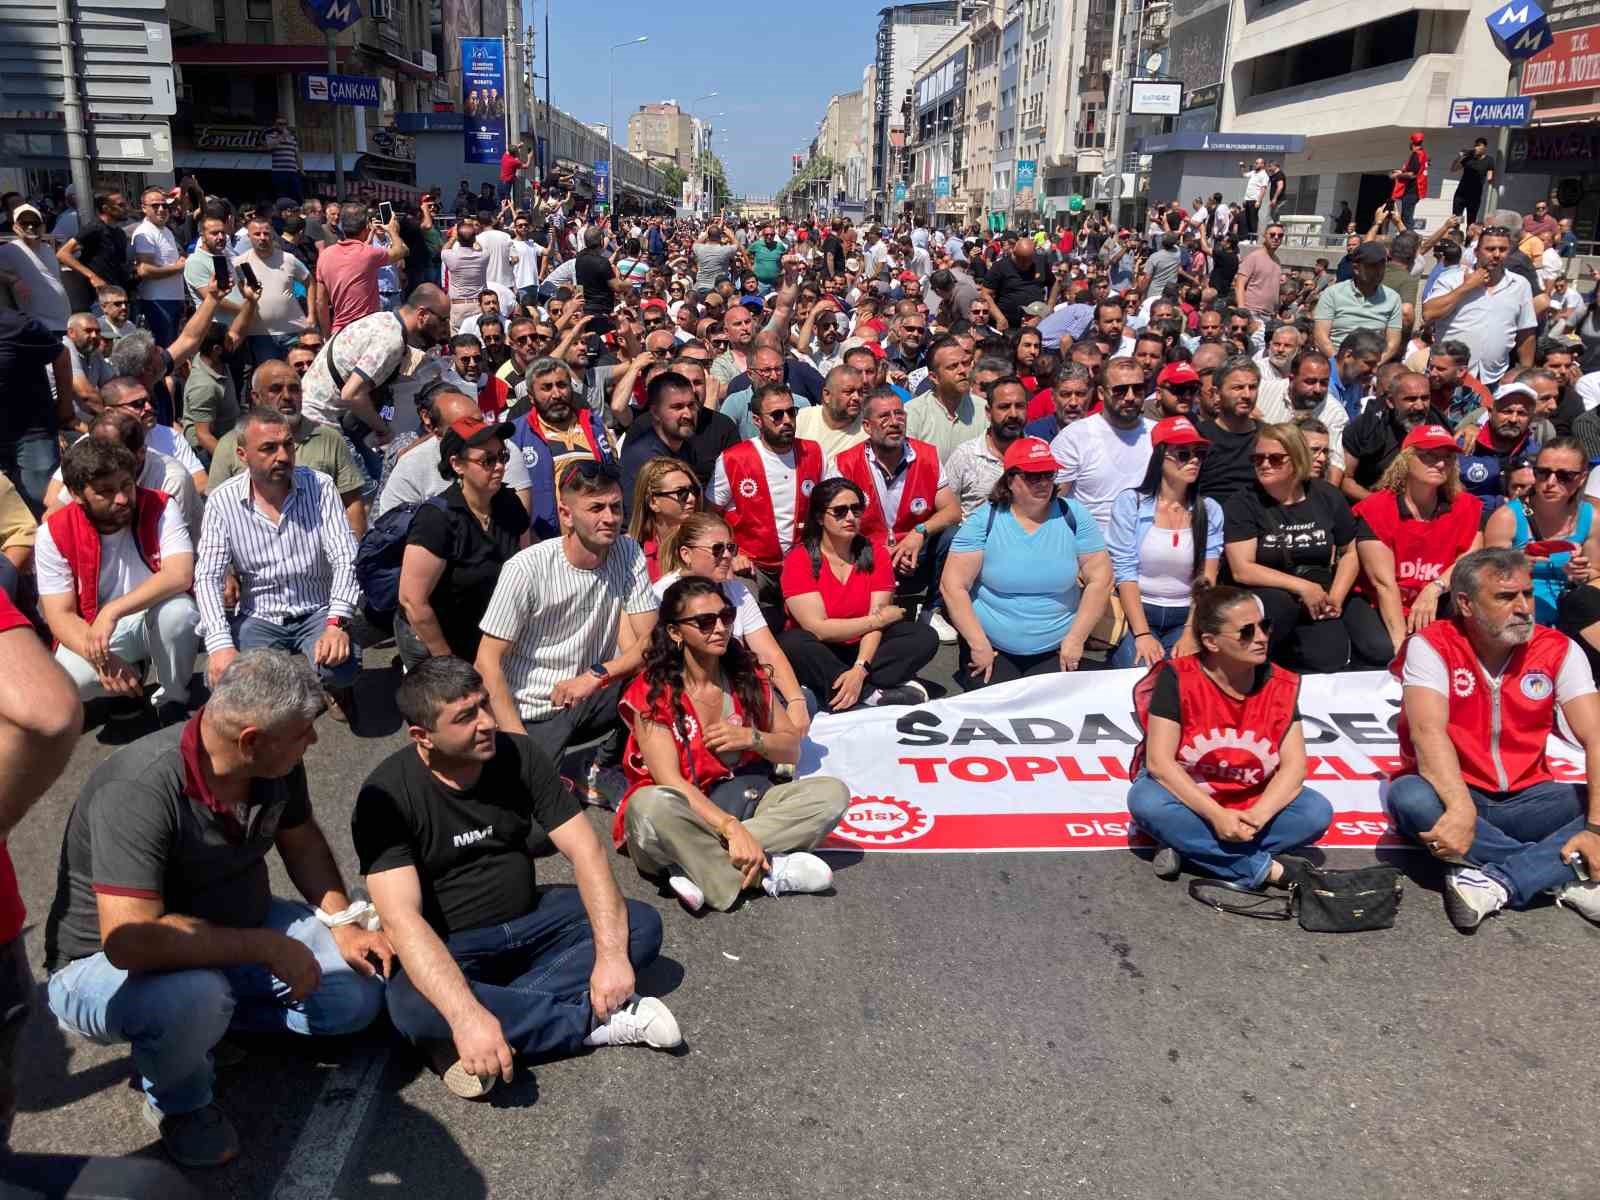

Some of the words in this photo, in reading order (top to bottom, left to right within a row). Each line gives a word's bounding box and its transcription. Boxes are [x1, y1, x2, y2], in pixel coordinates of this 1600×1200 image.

[1497, 5, 1529, 25] M
[1513, 28, 1545, 50] M
[329, 80, 378, 102] ÇANKAYA
[1473, 102, 1525, 124] ÇANKAYA
[1065, 819, 1131, 837] DİS
